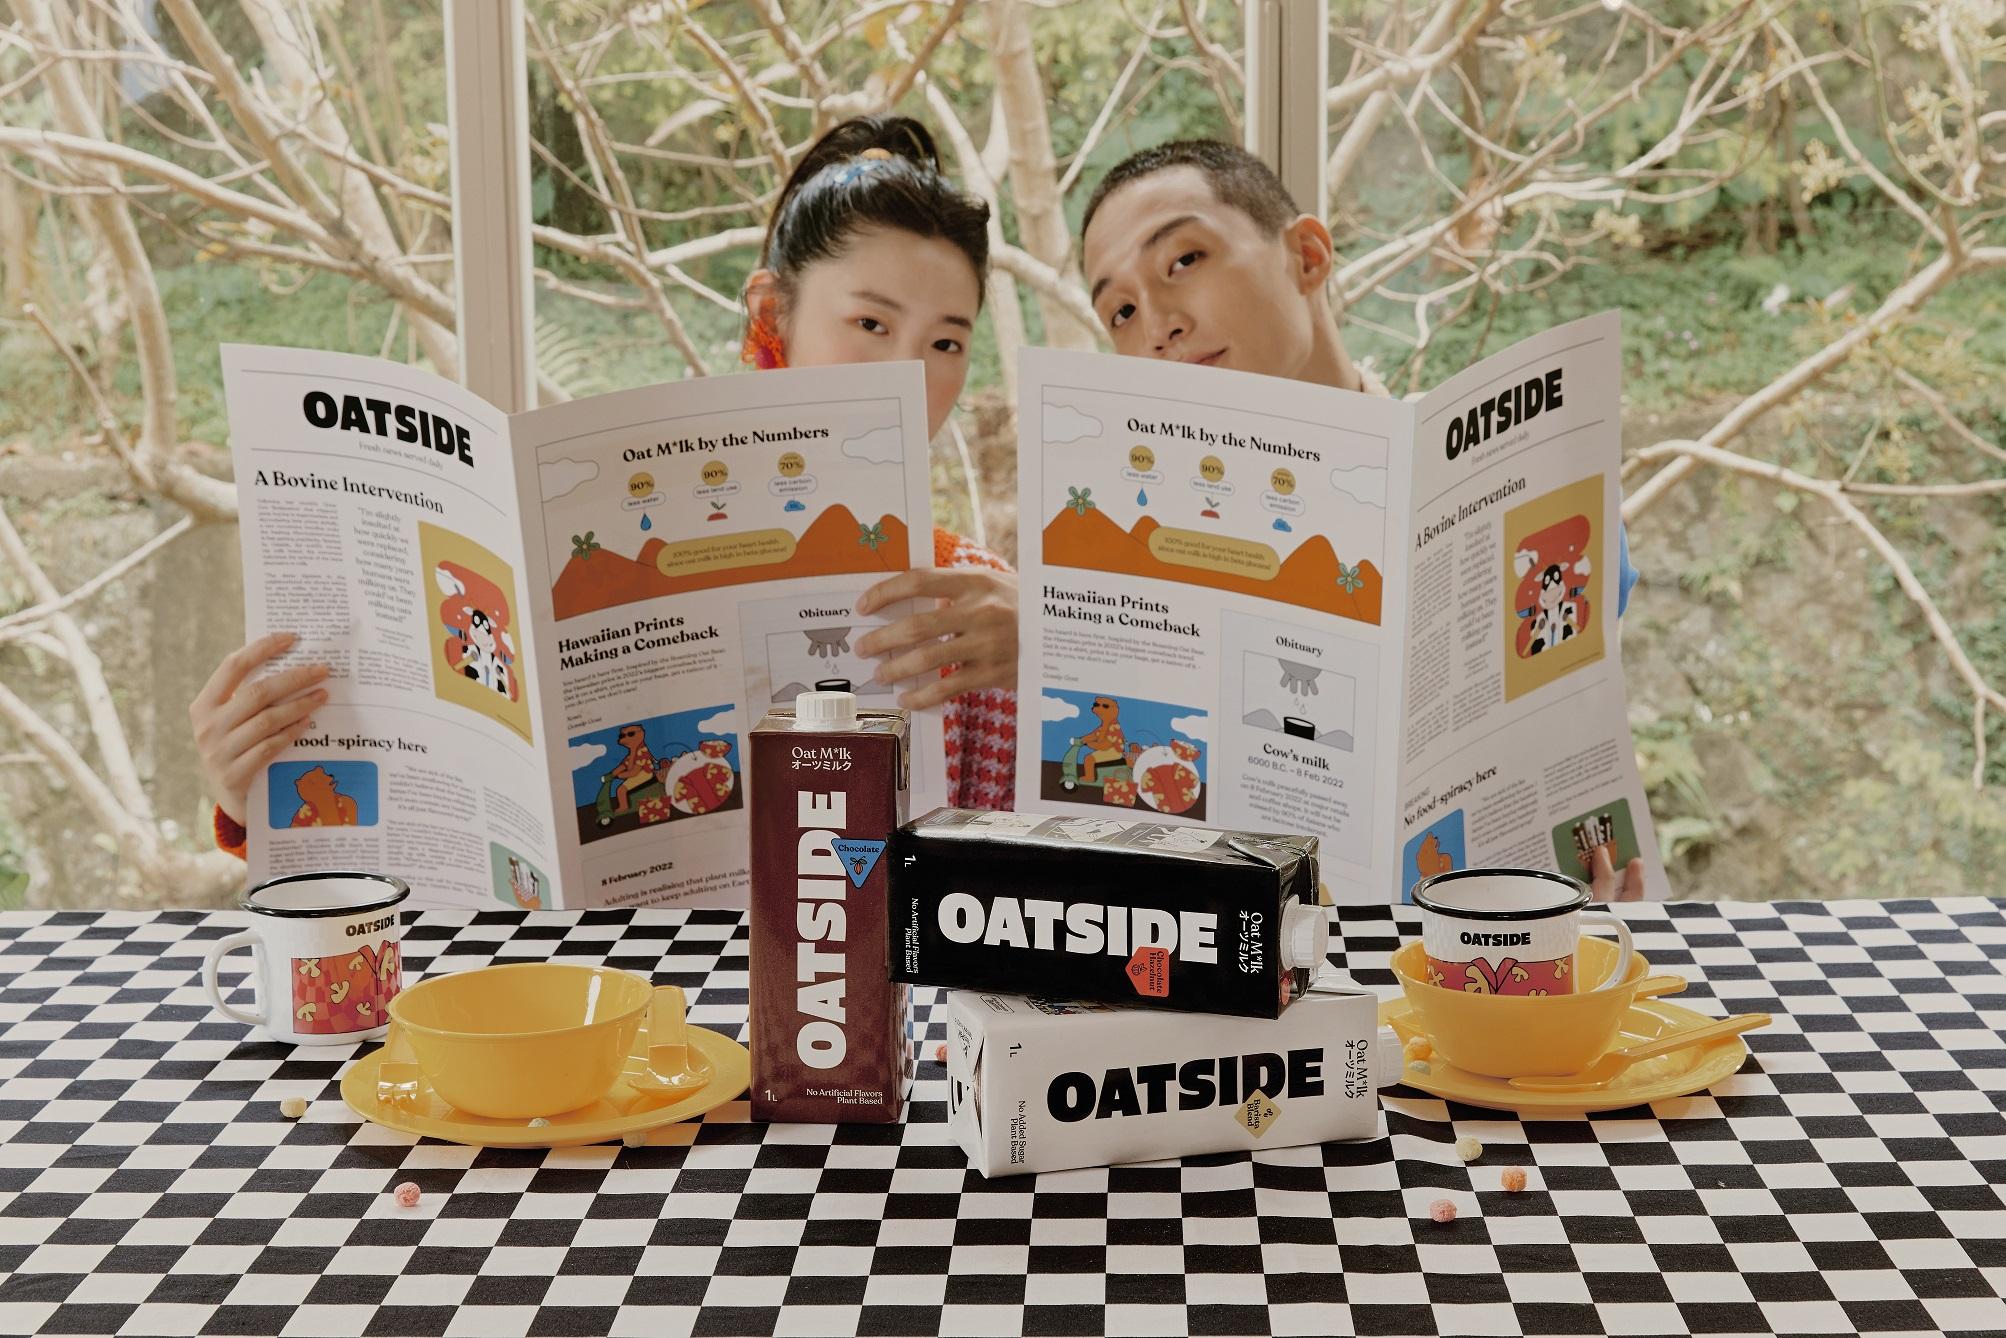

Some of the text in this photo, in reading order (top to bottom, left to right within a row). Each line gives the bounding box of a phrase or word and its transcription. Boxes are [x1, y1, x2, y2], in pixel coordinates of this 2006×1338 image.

[1446, 368, 1563, 461] OATSIDE
[303, 391, 474, 468] OATSIDE
[1127, 418, 1156, 434] Oat
[1200, 428, 1218, 446] by
[1222, 433, 1246, 448] the
[1250, 436, 1320, 462] Numbers
[623, 448, 652, 462] Oat
[699, 437, 718, 452] by
[722, 434, 748, 447] the
[752, 427, 829, 444] Numbers
[780, 462, 803, 470] 70%
[1131, 454, 1154, 465] 90%
[1201, 464, 1224, 475] 90%
[630, 480, 654, 491] 90%
[704, 470, 728, 479] 90%
[1273, 477, 1293, 488] 70%
[255, 470, 444, 514] A Bovine Intervention
[1415, 476, 1526, 552] A Bovine Intervention
[1043, 585, 1169, 614] Hawaiian Prints
[798, 607, 851, 620] Obituary
[1043, 604, 1201, 637] Making a Comeback
[558, 616, 685, 654] Hawaiian Prints
[1275, 635, 1324, 658] Obituary
[560, 626, 719, 671] Making a Comeback
[398, 738, 427, 753] here
[792, 747, 817, 759] Oat
[1264, 743, 1330, 771] Cow's milk
[791, 760, 852, 771] オーツミルク
[1248, 755, 1270, 768] 6000
[1296, 768, 1302, 777] 8
[1304, 770, 1320, 781] Feb
[1322, 775, 1344, 788] 2022
[1417, 779, 1473, 819] food-spiracy
[1476, 766, 1497, 784] here
[838, 844, 880, 854] Chocolate
[609, 868, 648, 884] February
[649, 862, 673, 873] 2022
[905, 855, 916, 868] 1L
[705, 872, 727, 883] plant
[729, 868, 750, 879] milk
[912, 898, 918, 910] No
[345, 914, 395, 937] OATSIDE
[796, 790, 847, 1070] OATSIDE
[937, 892, 1218, 965] OATSIDE
[1250, 912, 1263, 938] Oat
[1238, 910, 1249, 973] オーツミルク
[1460, 931, 1531, 946] OATSIDE
[1156, 950, 1164, 994] Chocolate
[1010, 1043, 1022, 1058] 1L
[1356, 1039, 1369, 1065] Oat
[1345, 1040, 1355, 1099] オーツミルク
[765, 1089, 778, 1102] 1L
[819, 1089, 852, 1097] Artificial
[1047, 1047, 1325, 1123] OATSIDE
[859, 1097, 882, 1105] Based
[1019, 1100, 1025, 1112] No
[1018, 1140, 1026, 1164] Sugar
